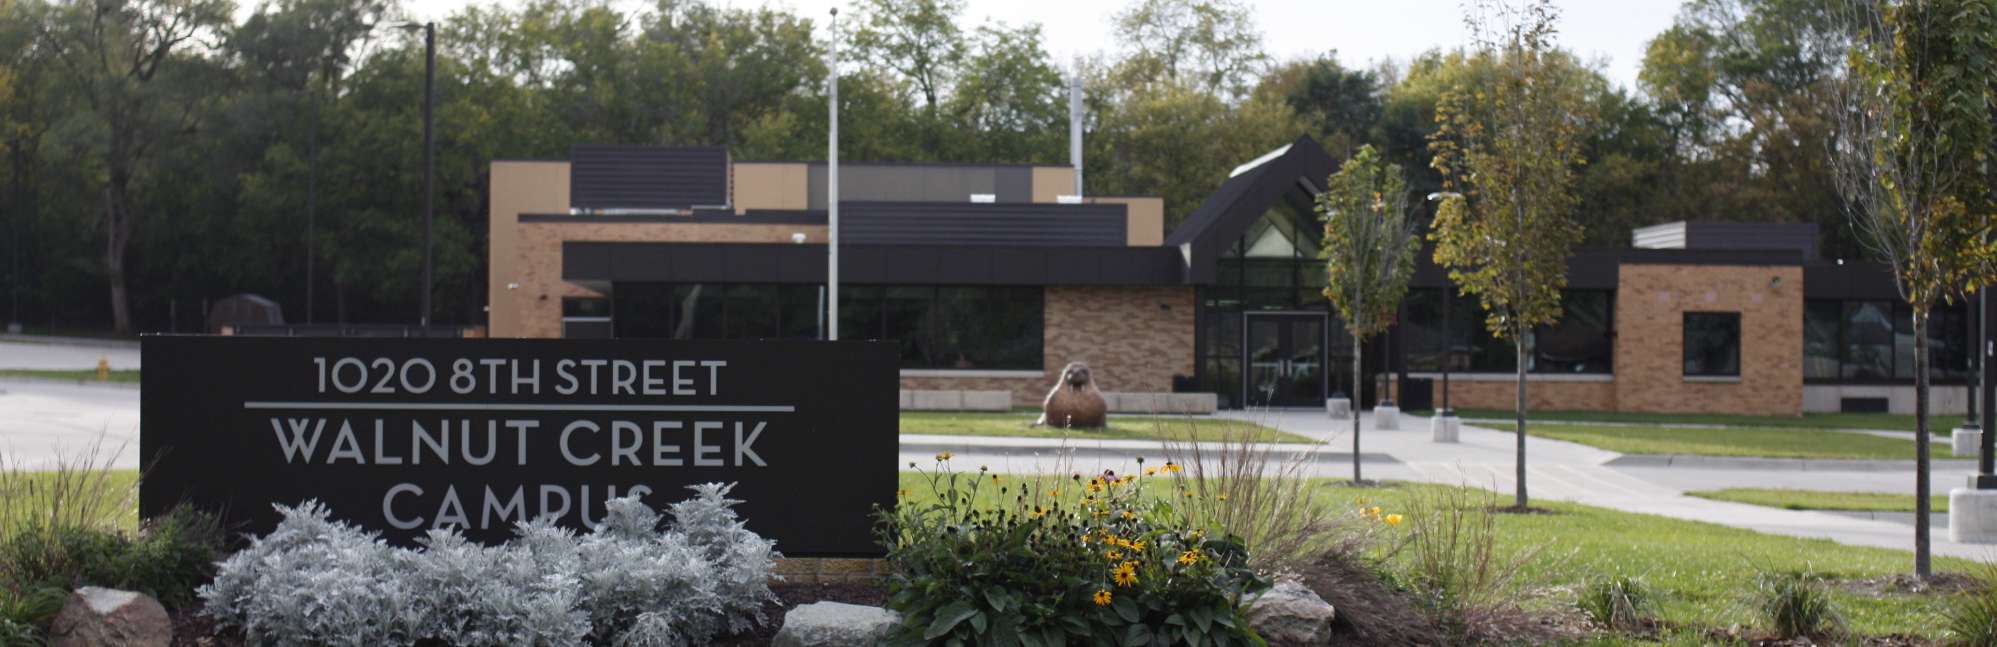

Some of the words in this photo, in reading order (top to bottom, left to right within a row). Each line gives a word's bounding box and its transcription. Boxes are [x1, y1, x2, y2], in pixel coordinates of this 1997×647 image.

[313, 357, 436, 393] 1020
[449, 358, 539, 394] 8TH
[554, 358, 726, 395] STREET
[270, 418, 539, 465] WALNUT
[559, 419, 767, 466] CREEK
[382, 483, 654, 530] CAMPU
